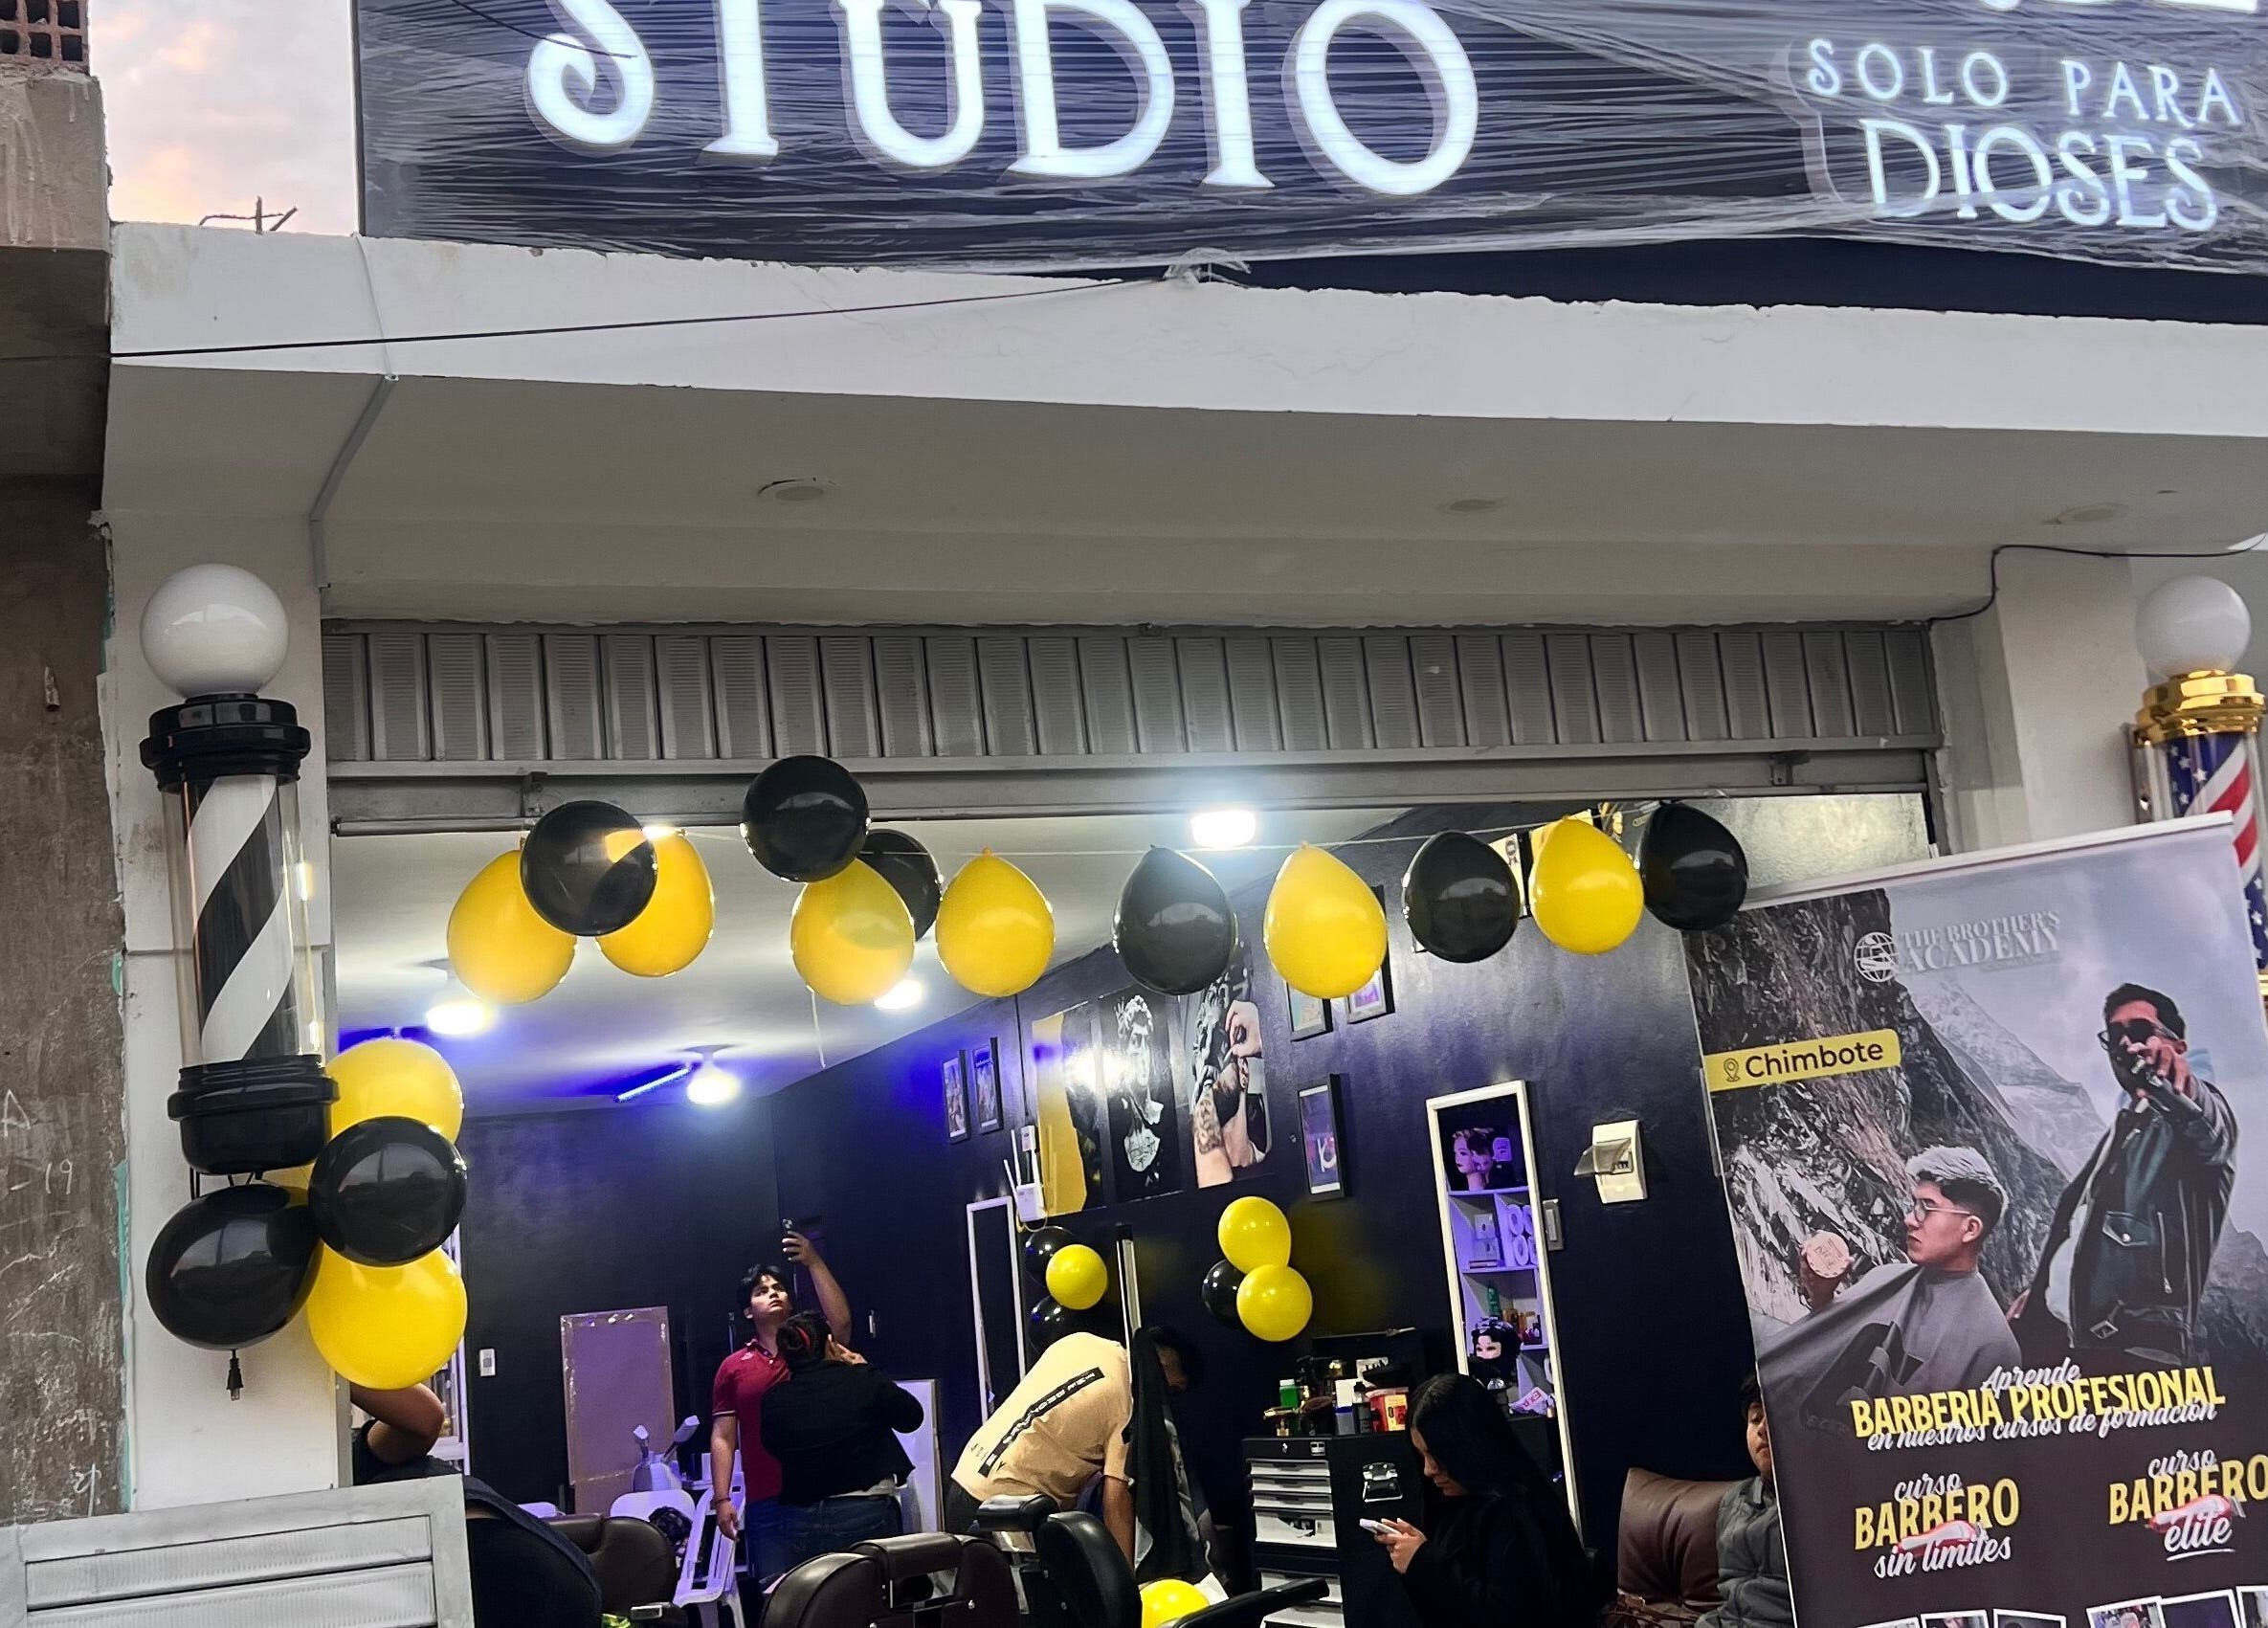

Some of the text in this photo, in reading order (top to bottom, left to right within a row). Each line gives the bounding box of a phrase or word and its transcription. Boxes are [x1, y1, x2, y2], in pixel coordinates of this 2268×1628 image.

[1807, 38, 2243, 128] SOLO PARA
[1859, 117, 2219, 231] DIOSES
[1900, 928, 2060, 972] ACADEMY
[1903, 928, 1940, 948] THE
[1745, 1042, 1884, 1078] Chimbote
[1980, 1356, 2081, 1400] Aprende
[2010, 1366, 2226, 1422] PROFESIONAL
[1867, 1430, 1894, 1451] en
[1897, 1416, 1986, 1449] nuestros
[1992, 1414, 2062, 1440] cursos
[2068, 1408, 2096, 1433] de
[2147, 1449, 2217, 1479] curso
[1894, 1472, 1962, 1503] curso
[2109, 1454, 2268, 1525] BARBERO
[1855, 1478, 2020, 1550] BARBERO
[1874, 1536, 2012, 1578] sin limites
